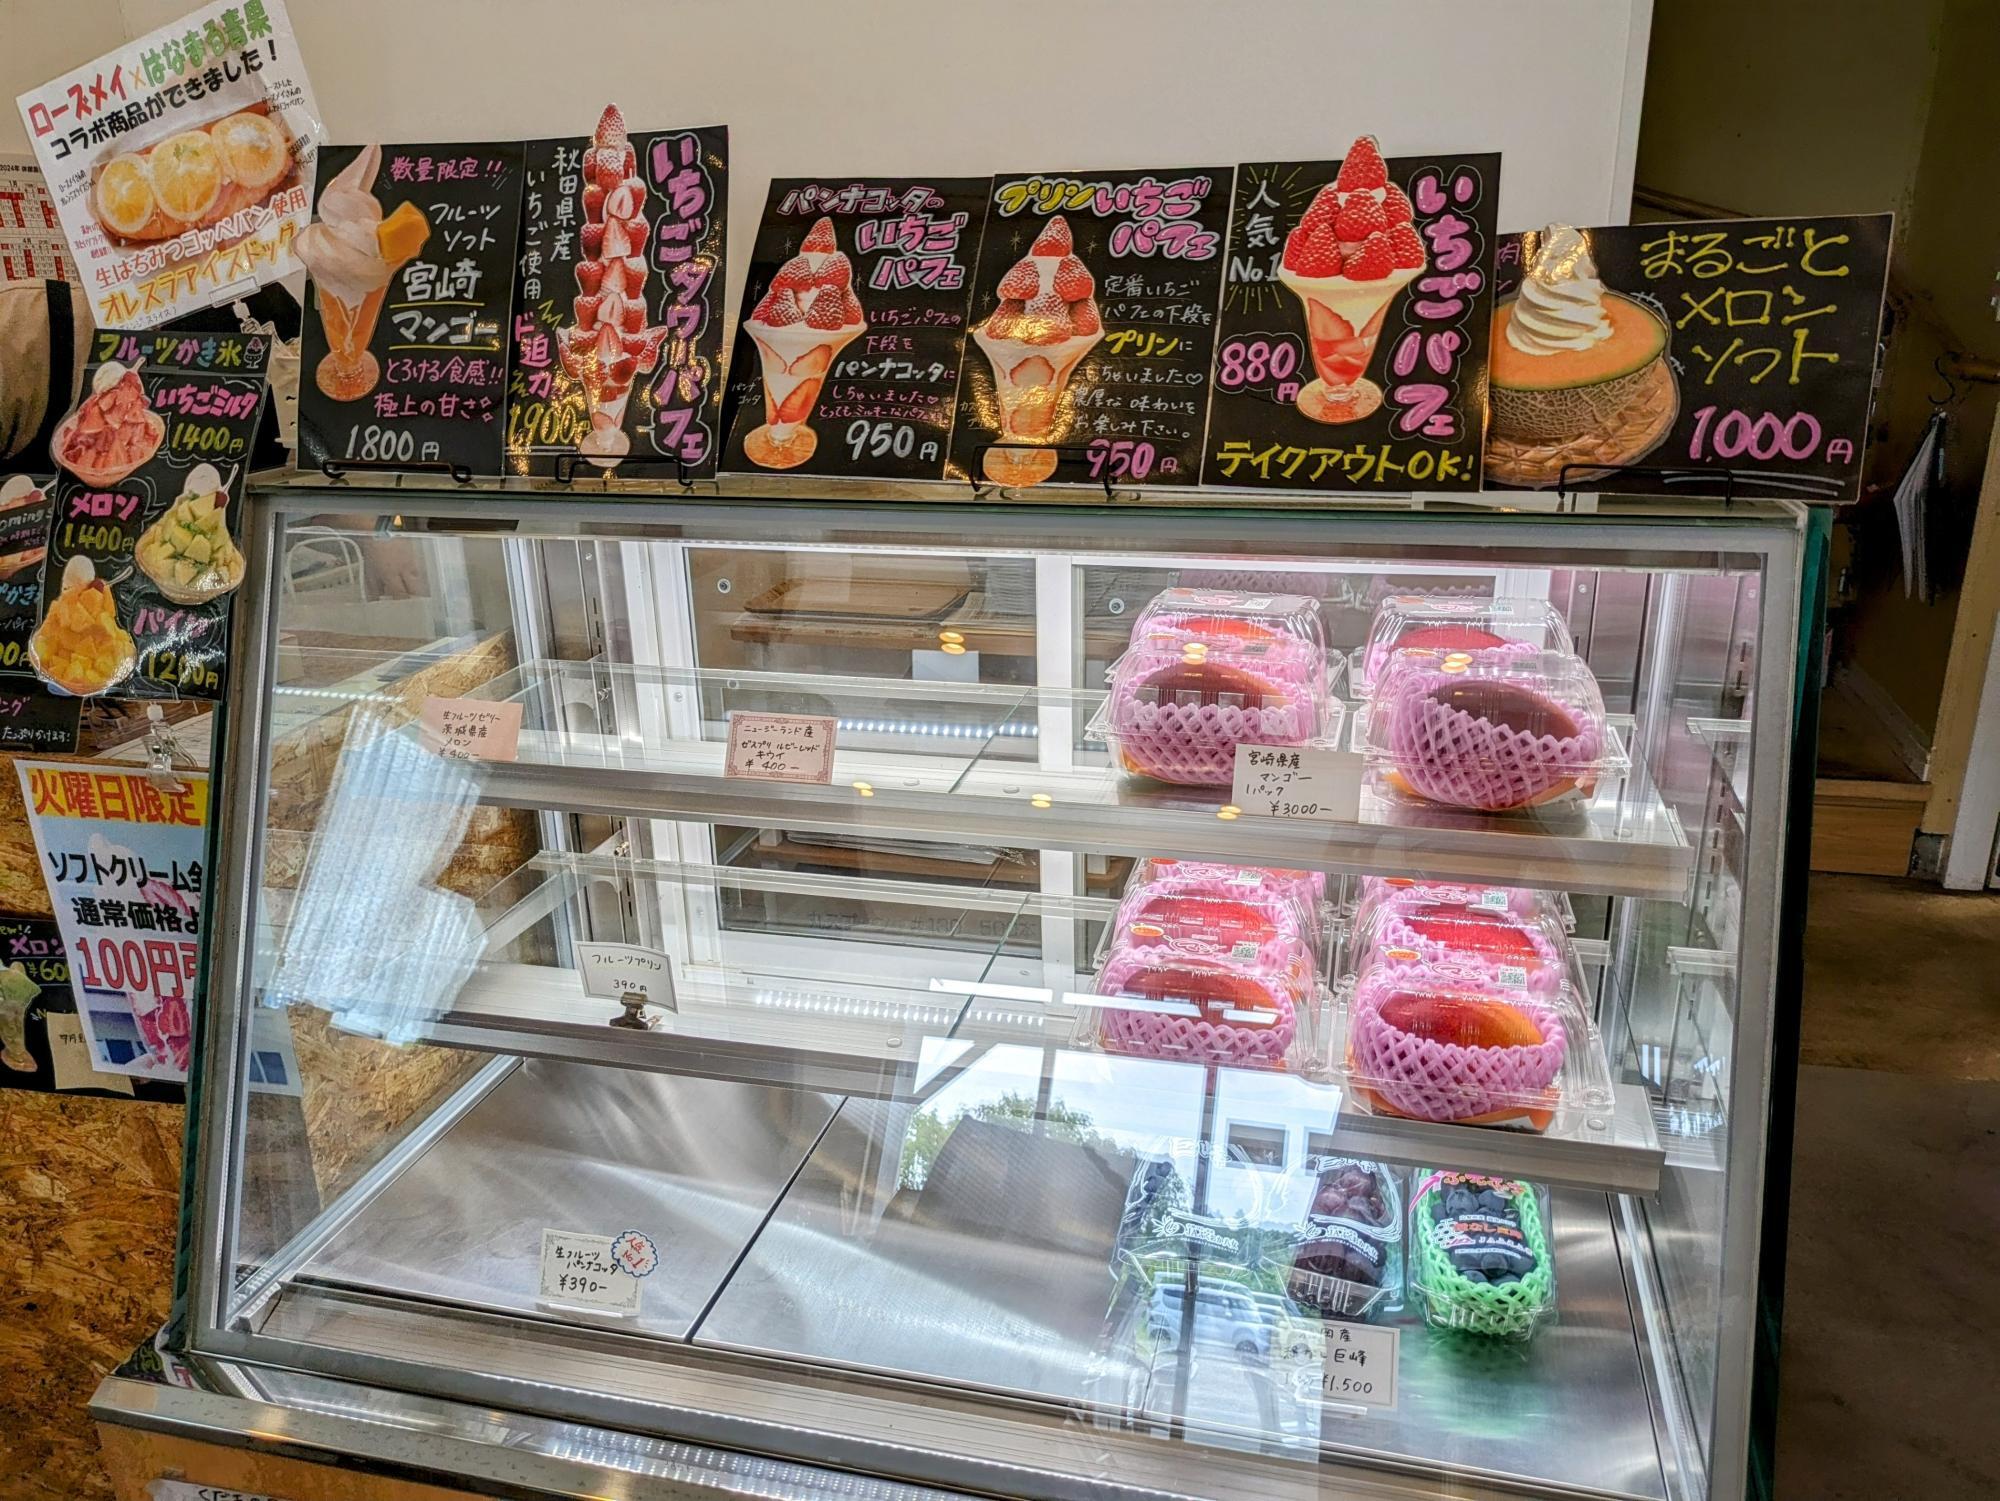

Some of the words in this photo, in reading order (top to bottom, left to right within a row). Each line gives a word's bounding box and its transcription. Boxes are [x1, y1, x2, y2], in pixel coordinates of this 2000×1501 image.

[551, 146, 581, 262] 秋田県産
[777, 184, 944, 215] パンナコッタの
[995, 174, 1212, 218] プリンいちご
[429, 203, 501, 224] フルーツ
[1245, 180, 1280, 249] 人気
[95, 188, 308, 289] 生はちみつコッペパン使用
[444, 227, 496, 253] ソフト
[519, 171, 549, 300] いちご使用
[857, 212, 967, 253] いちご
[1110, 219, 1219, 260] パフェ
[1640, 226, 1849, 279] まるごと
[402, 258, 483, 301] 宮崎
[869, 255, 967, 290] パフェ
[1104, 273, 1200, 297] 定番いちご
[652, 137, 706, 460] いちごタワーパフェ
[1394, 172, 1484, 436] いちごパフェ
[1676, 286, 1838, 330] メロン
[392, 311, 498, 344] マンゴー
[870, 306, 961, 326] いちごパフェの
[1104, 303, 1212, 326] パフェの下段を
[98, 335, 242, 368] フルーツかき氷
[866, 334, 913, 354] 下段を
[1104, 329, 1193, 357] プリンに
[1692, 327, 1840, 385] ソフト
[834, 357, 956, 383] パンナコッタに
[155, 383, 260, 421] いちごミルク
[845, 420, 939, 462] 950円
[1086, 438, 1178, 480] 950円
[69, 493, 140, 521] メロン
[0, 584, 41, 606] かき
[133, 608, 209, 639] パイン
[443, 710, 501, 723] 生フルーツゼリー
[442, 724, 488, 738] 茨城県産
[444, 737, 472, 747] メロン
[744, 724, 814, 738] ニュージーランド産
[756, 751, 785, 759] キウイ
[1248, 750, 1301, 769] 宮崎県産
[1246, 784, 1284, 796] 1パック
[1260, 771, 1312, 782] マンゴー
[30, 769, 201, 826] 火曜日限定
[26, 960, 71, 982] ¥60
[592, 954, 661, 971] フルーツプリン
[613, 979, 648, 992] 390円
[555, 1245, 600, 1261] 生フルーツ
[626, 1237, 646, 1254] 人気
[567, 1260, 618, 1275] パンナコッタ
